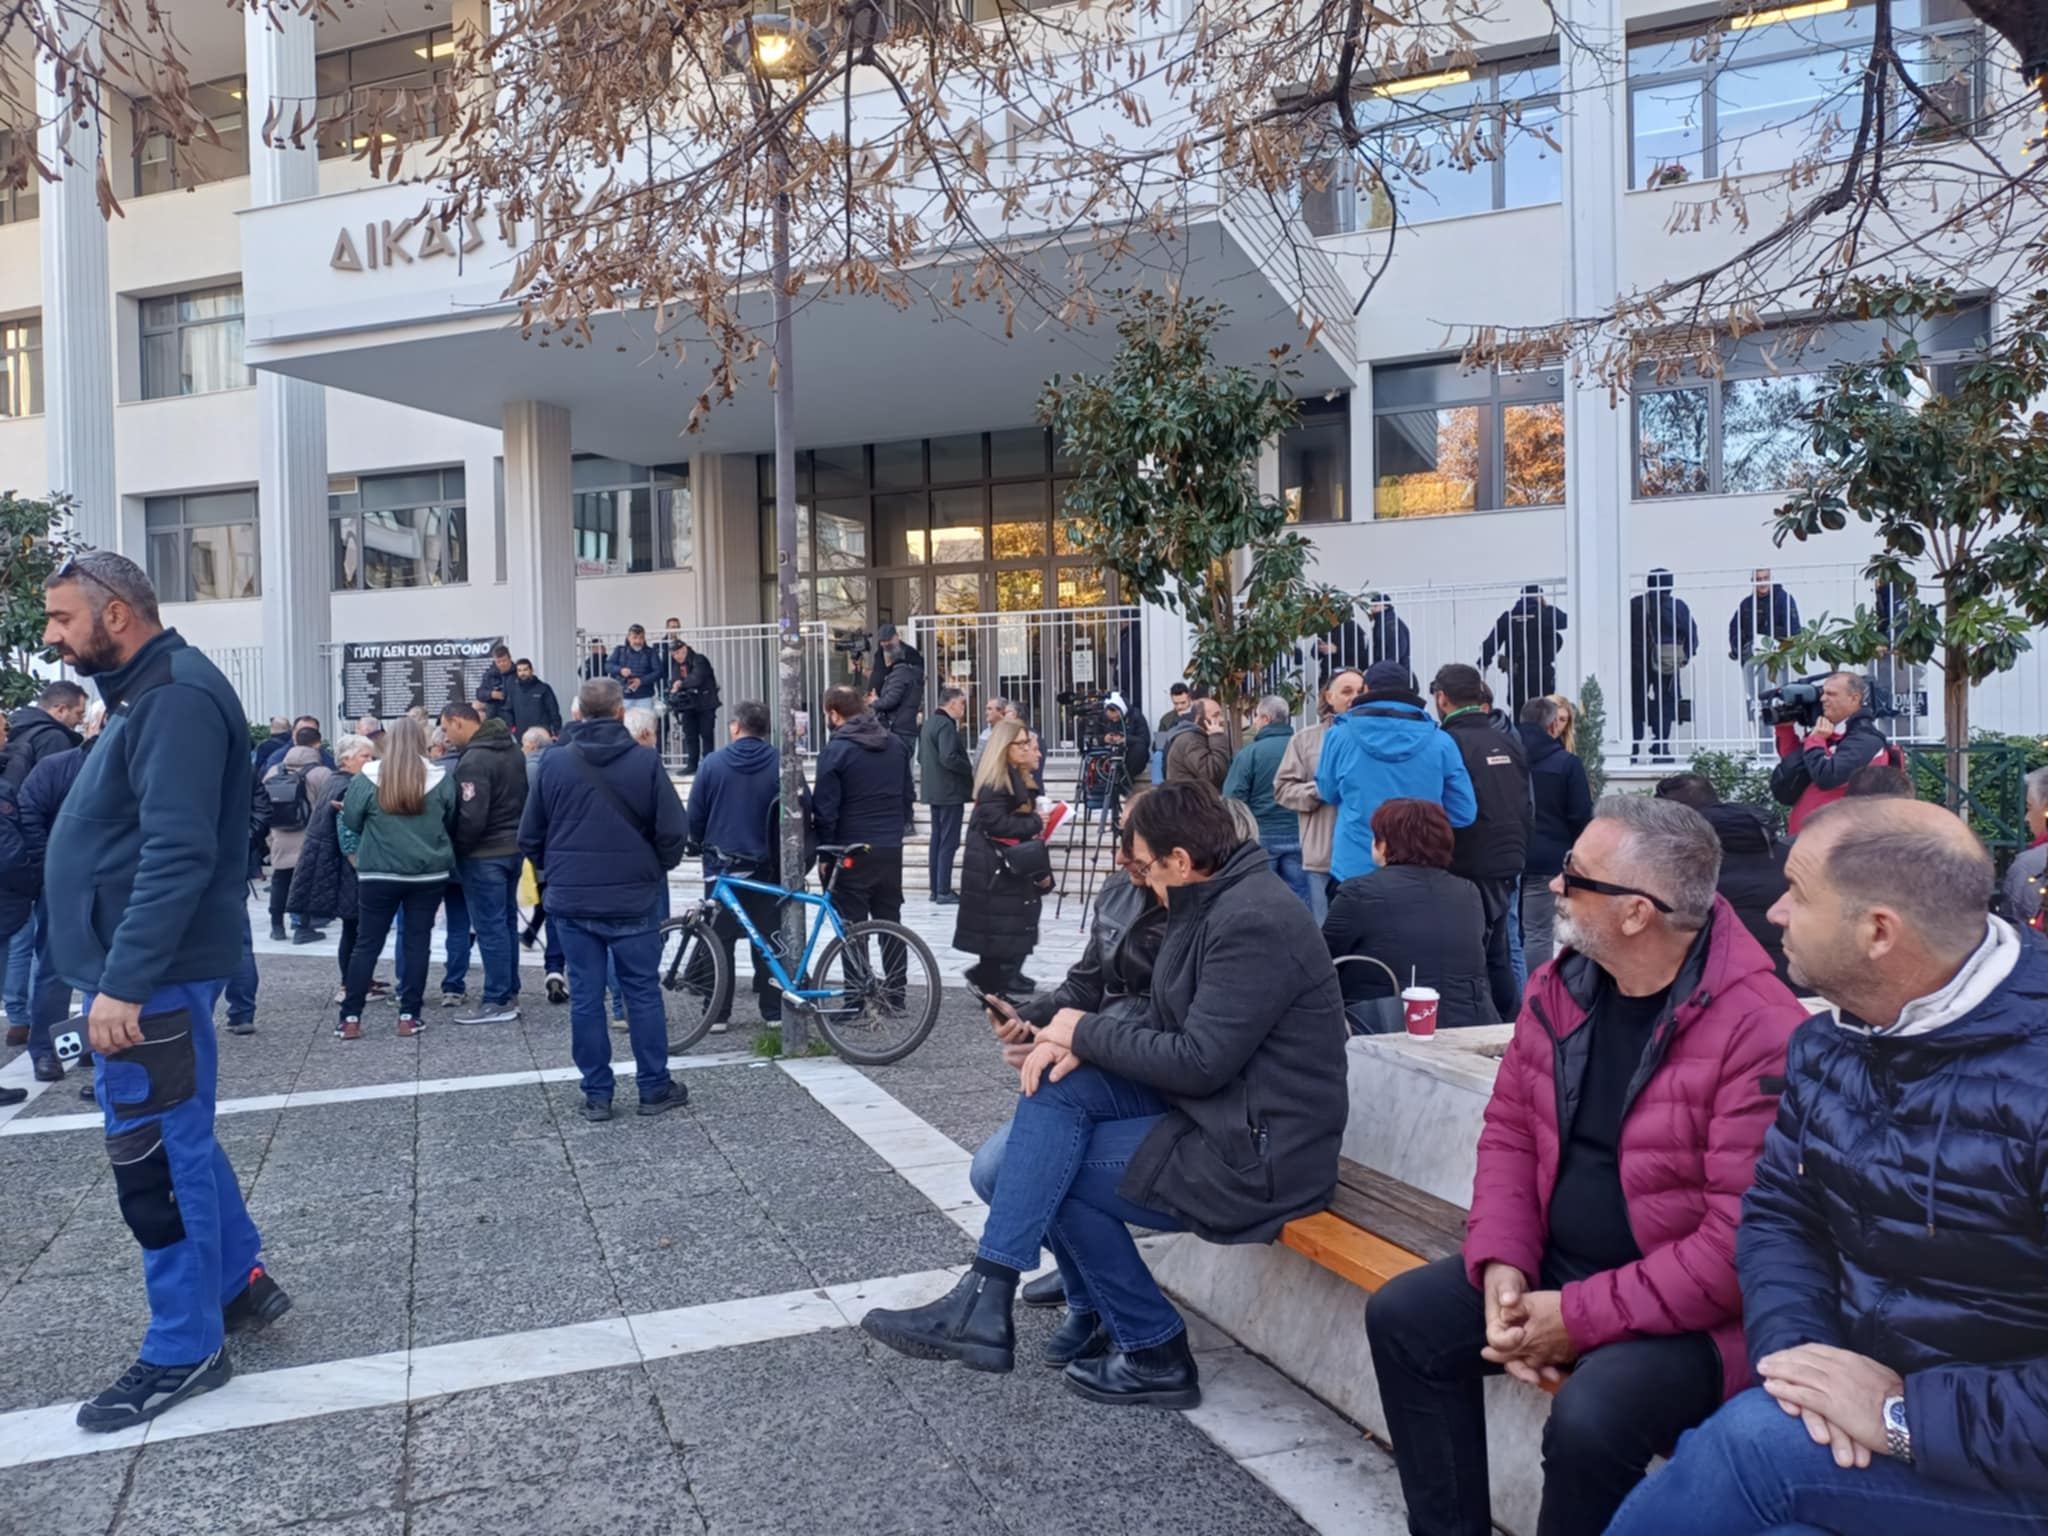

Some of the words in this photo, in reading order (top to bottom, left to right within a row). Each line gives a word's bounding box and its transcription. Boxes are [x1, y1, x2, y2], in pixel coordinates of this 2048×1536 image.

[354, 646, 380, 659] ΓΙΑΤΙ
[382, 645, 406, 658] ΔΕΝ
[408, 644, 432, 657] ΕΧΩ
[433, 643, 490, 655] ΟΞΥΓΟΝΟ
